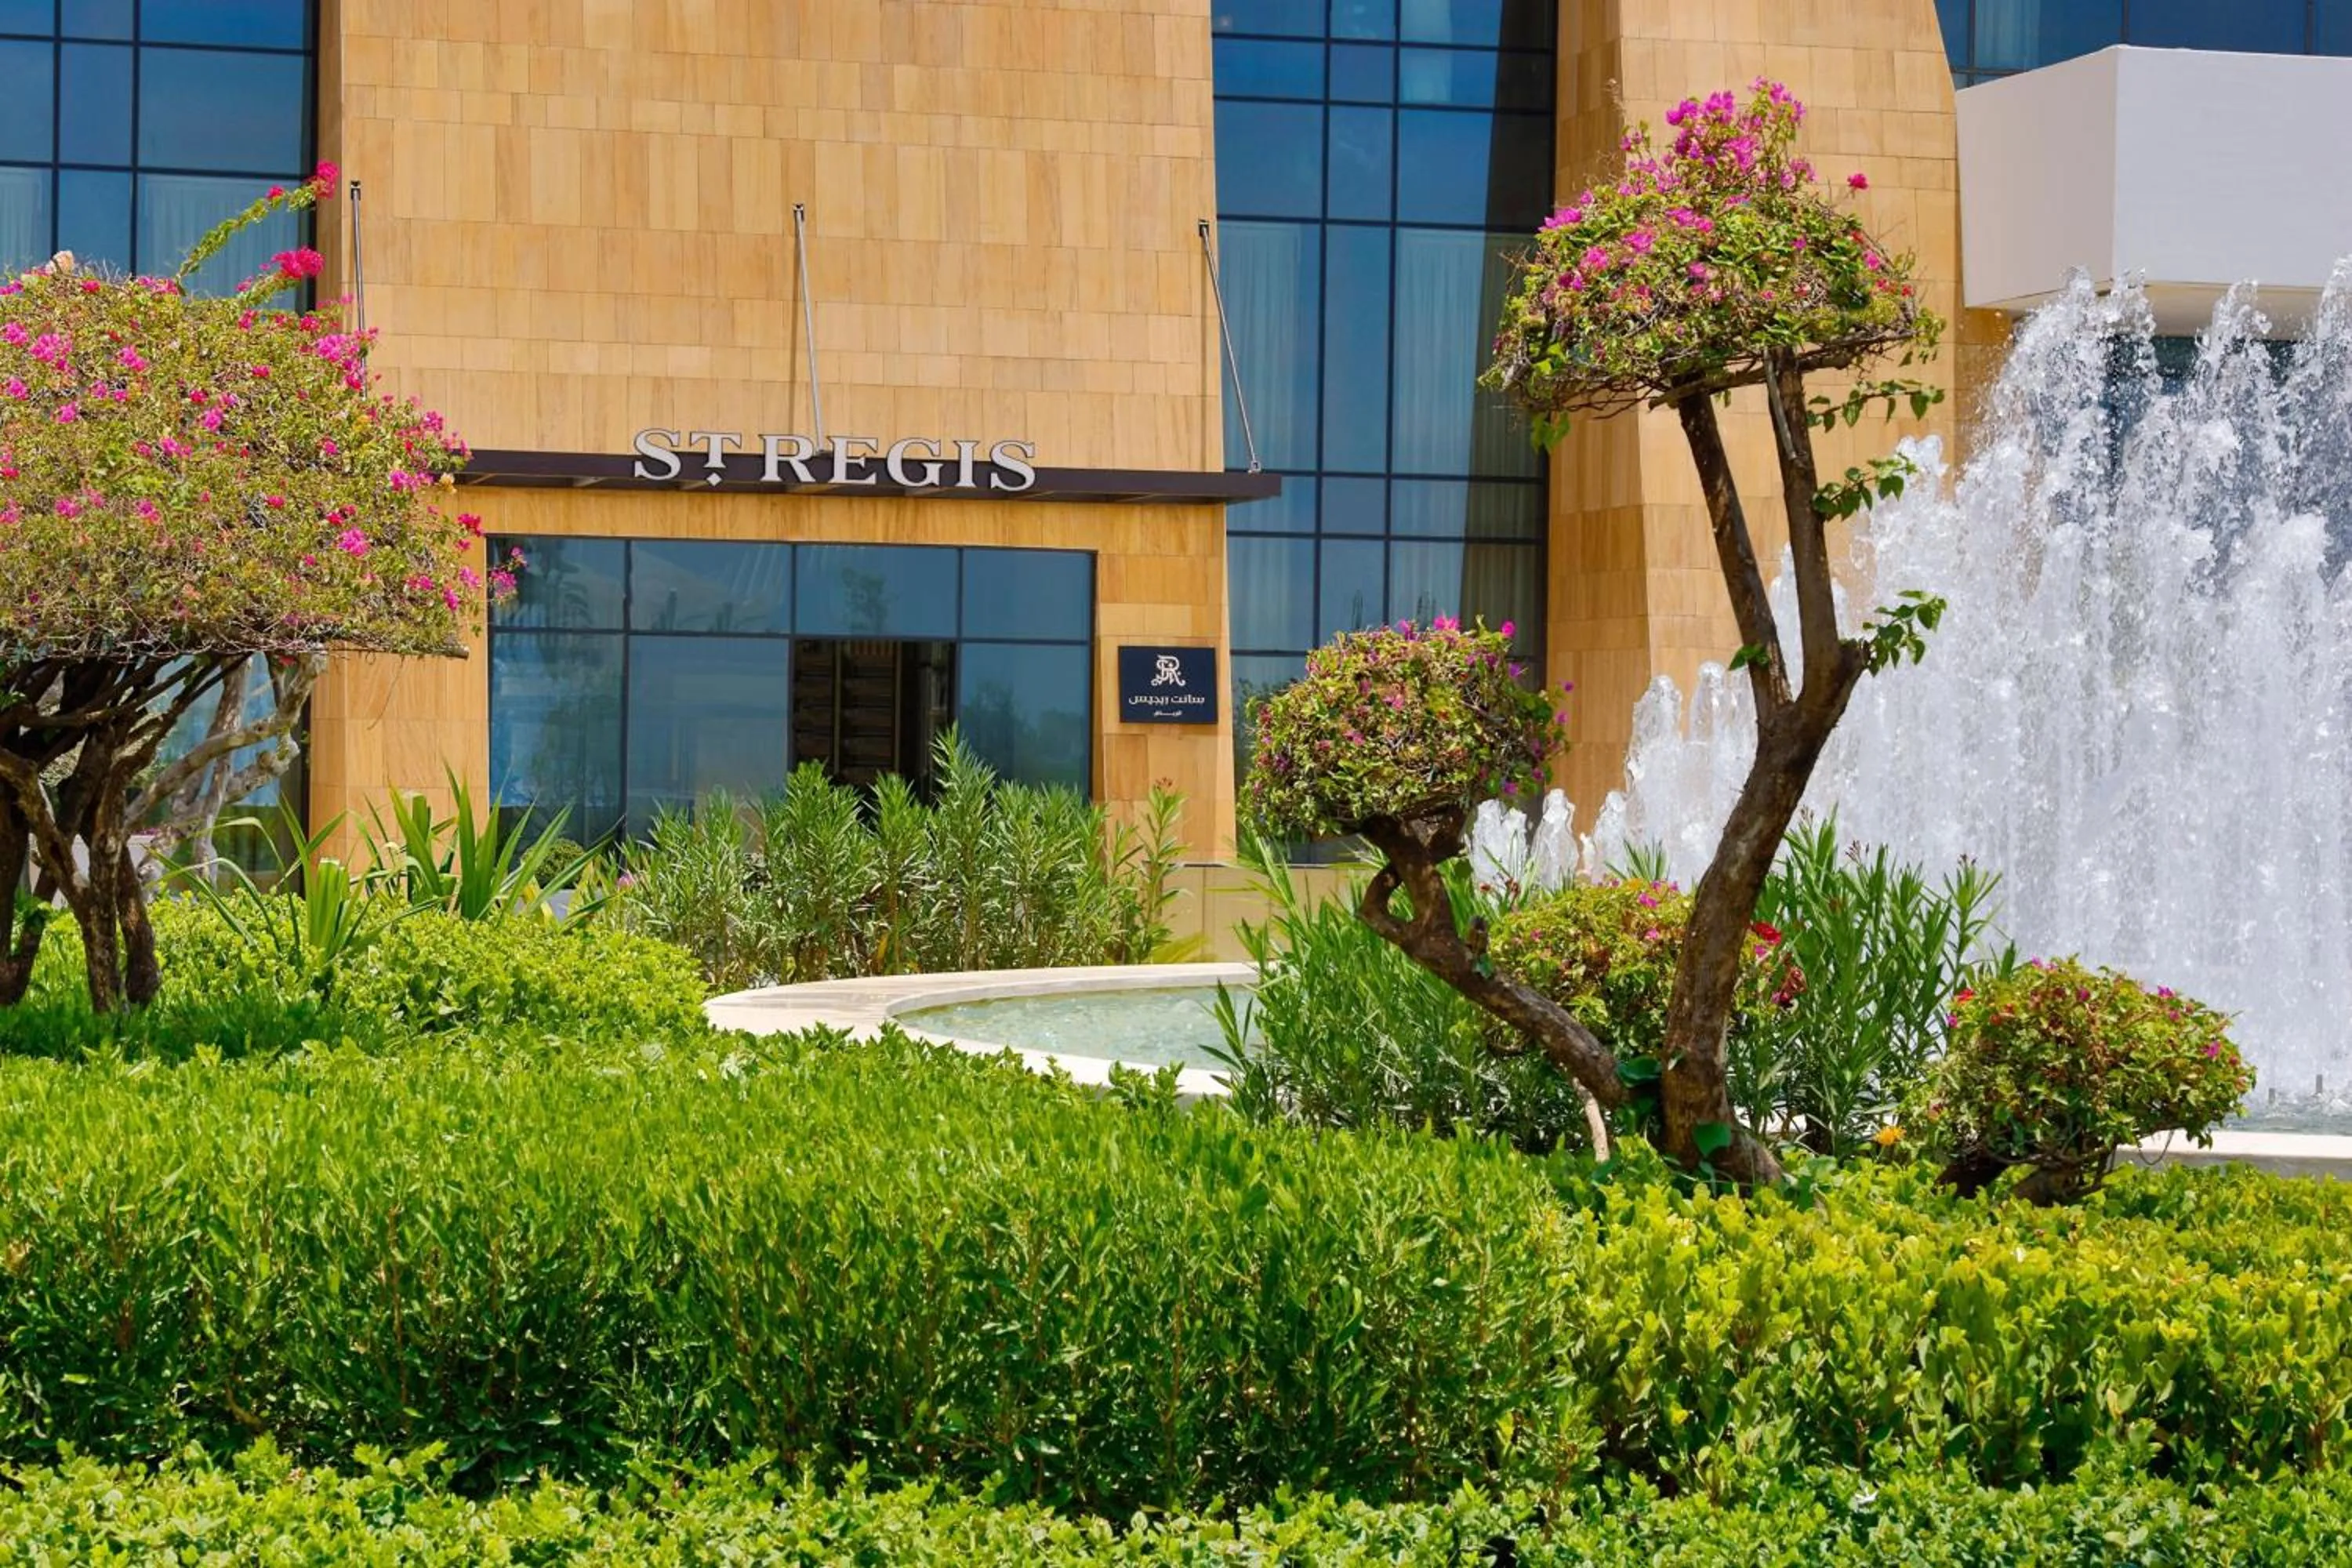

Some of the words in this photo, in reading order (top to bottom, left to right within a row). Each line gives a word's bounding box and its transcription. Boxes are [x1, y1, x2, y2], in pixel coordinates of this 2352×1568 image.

[757, 434, 1036, 492] REGIS
[1128, 695, 1169, 705] ريجيس
[1171, 694, 1205, 704] سانت
